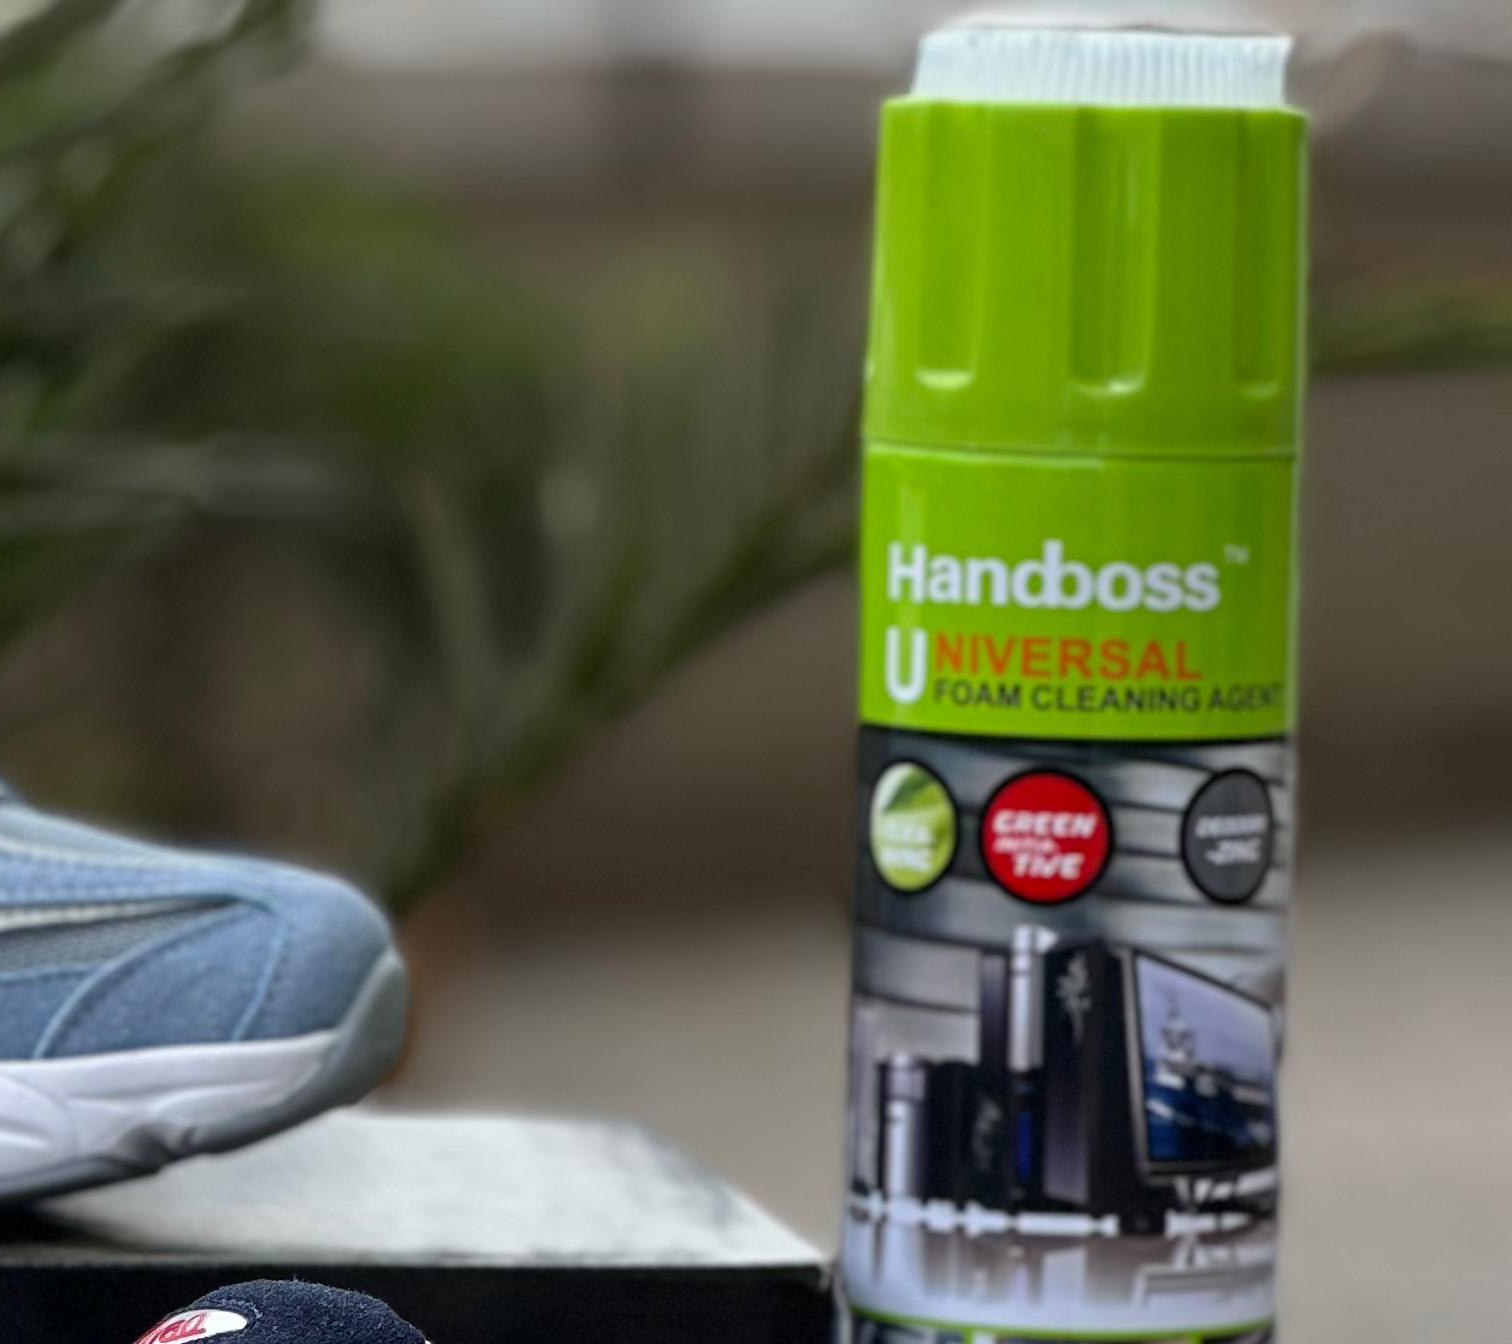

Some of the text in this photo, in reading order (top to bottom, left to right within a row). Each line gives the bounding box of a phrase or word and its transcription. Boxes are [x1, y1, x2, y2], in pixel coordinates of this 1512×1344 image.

[886, 538, 1222, 612] Handboss
[885, 626, 1204, 704] UNIVERSAL
[933, 681, 1022, 707] FOAM
[1031, 683, 1201, 713] CLEANING
[992, 808, 1097, 839] GREEN
